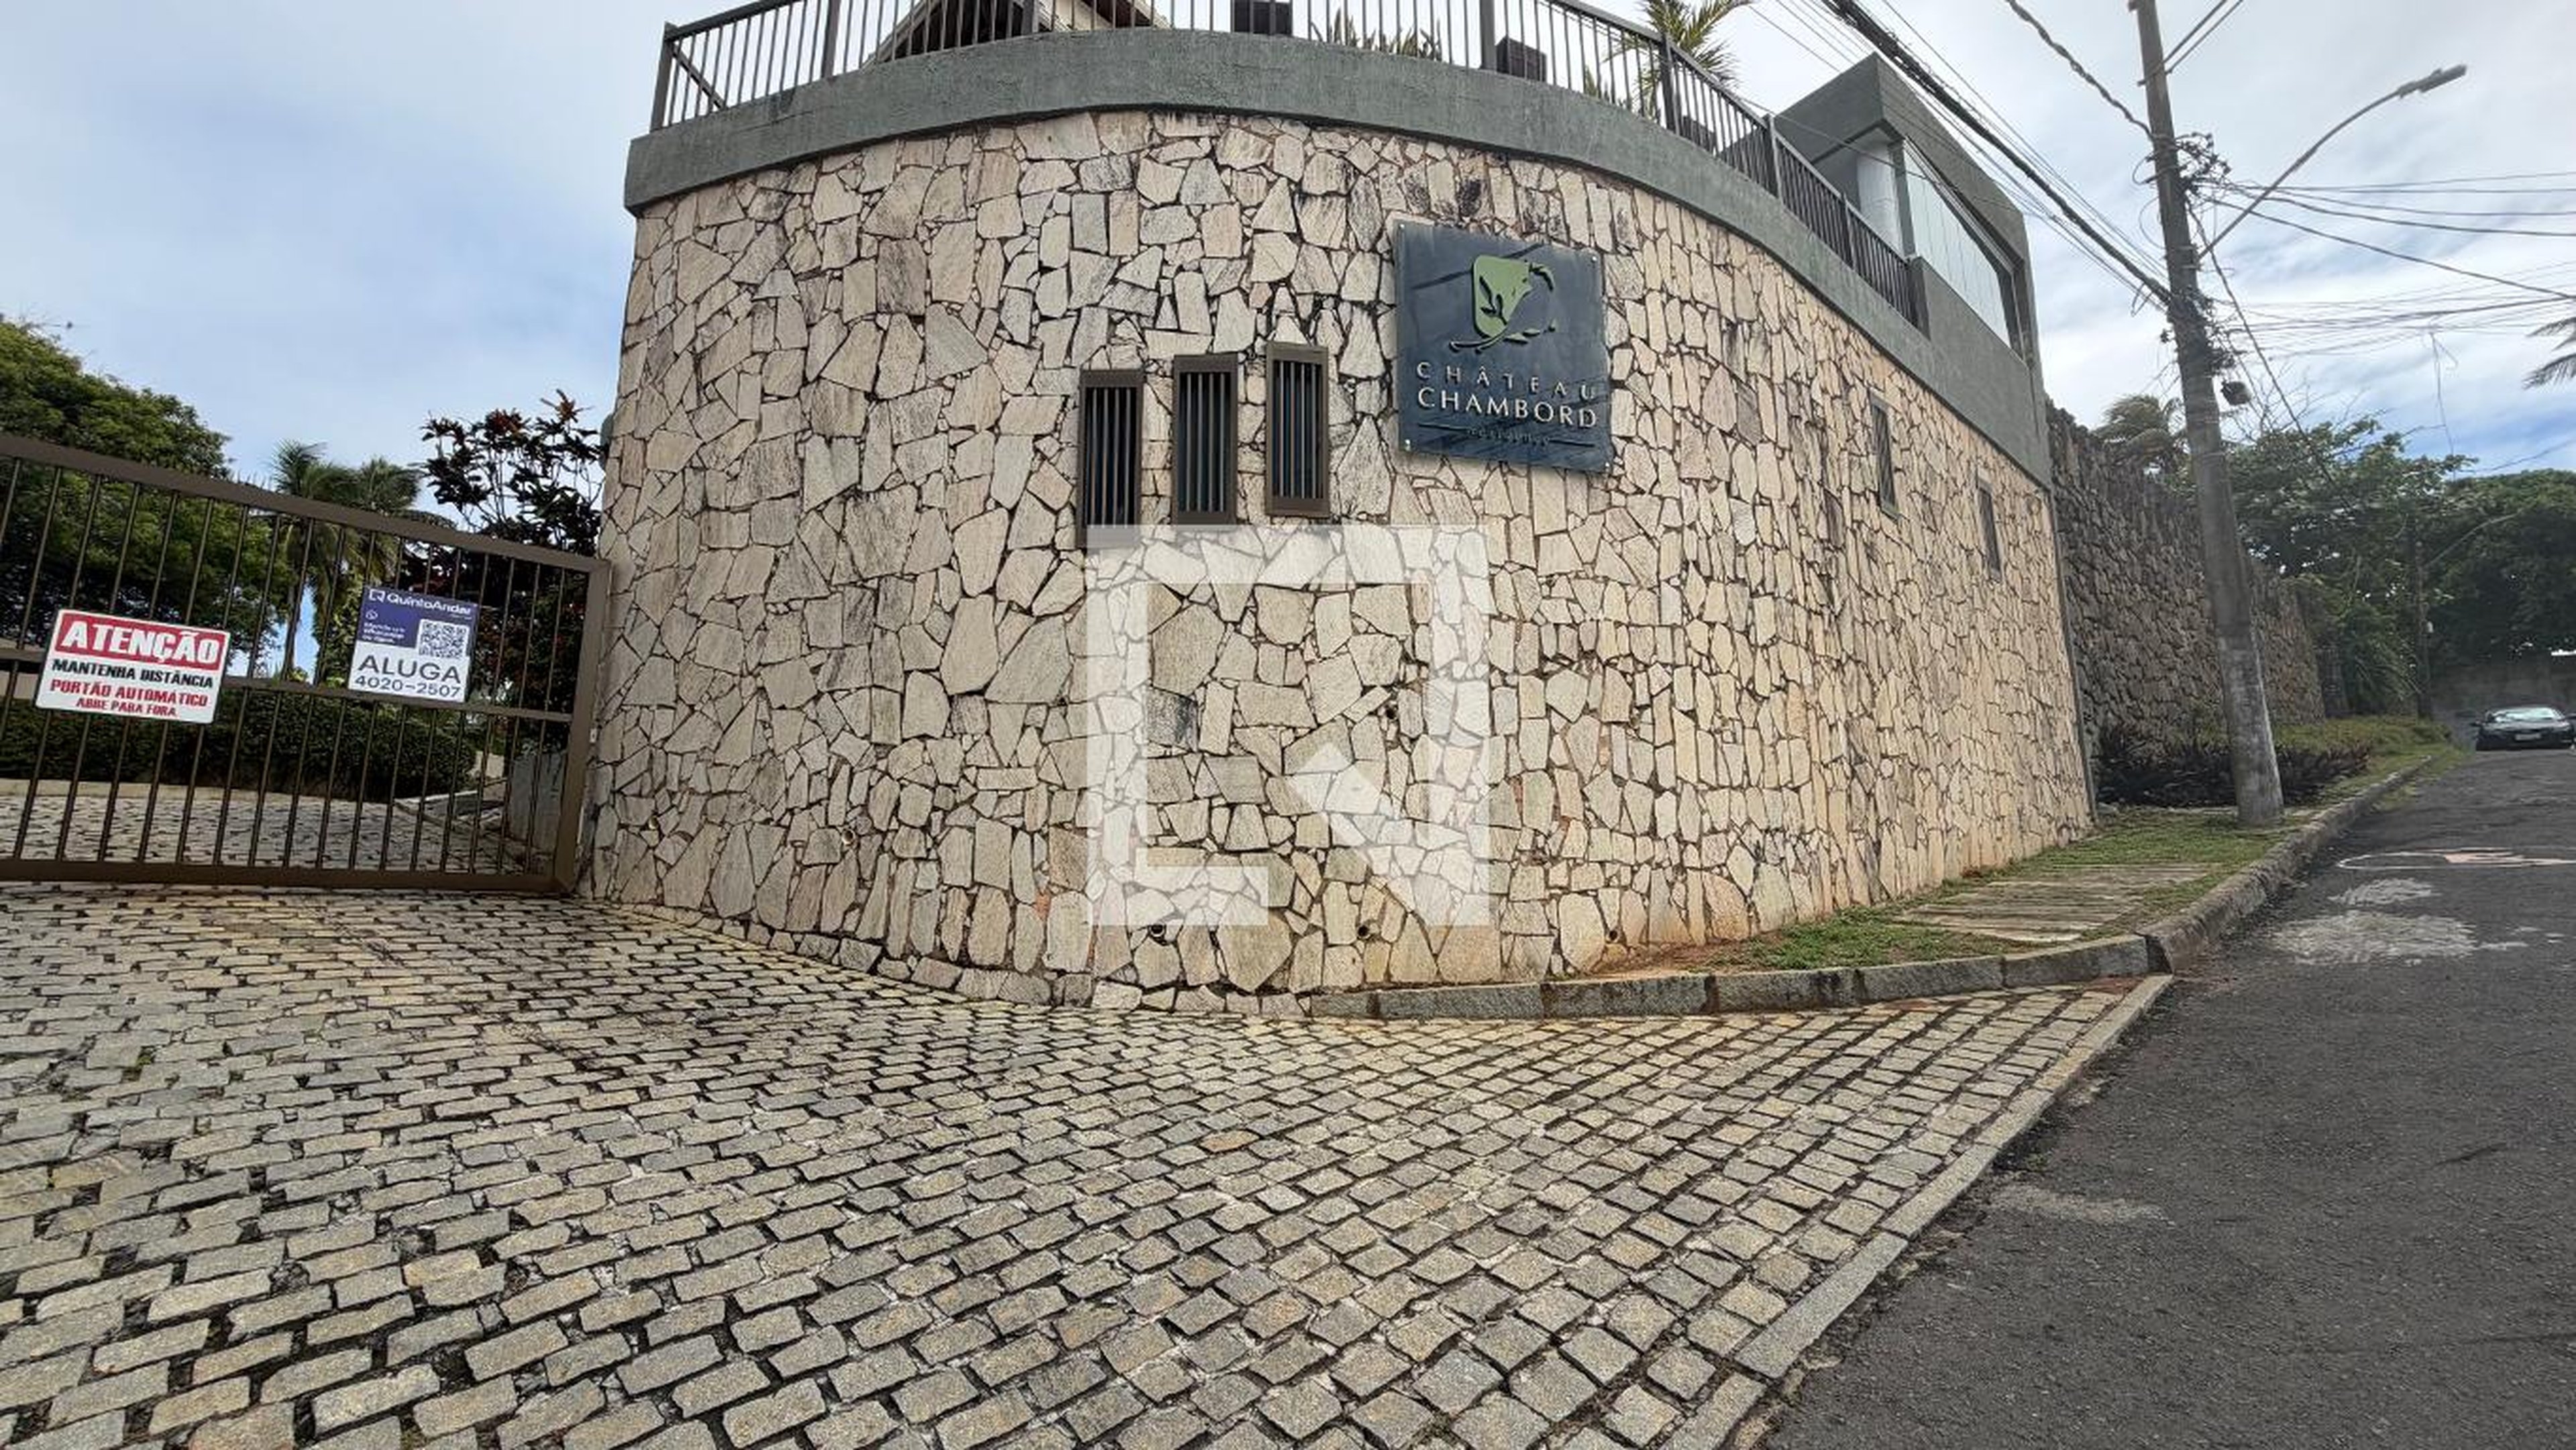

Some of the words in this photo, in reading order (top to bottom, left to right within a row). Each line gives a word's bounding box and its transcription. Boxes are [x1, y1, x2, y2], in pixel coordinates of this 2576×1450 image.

[1417, 362, 1596, 400] CHÂTEAU
[1417, 386, 1597, 428] CHAMBORD
[60, 621, 220, 663] ATENÇÃO
[52, 658, 136, 680] MANTENHA
[139, 669, 213, 688] DISTÂNCIA
[358, 655, 461, 684] ALUGA
[50, 678, 111, 697] PORTÃO
[115, 684, 209, 707] AUTOMÁTICO
[355, 676, 461, 697] 4020-2507
[76, 697, 107, 710] ABRE
[110, 700, 142, 713] PARA
